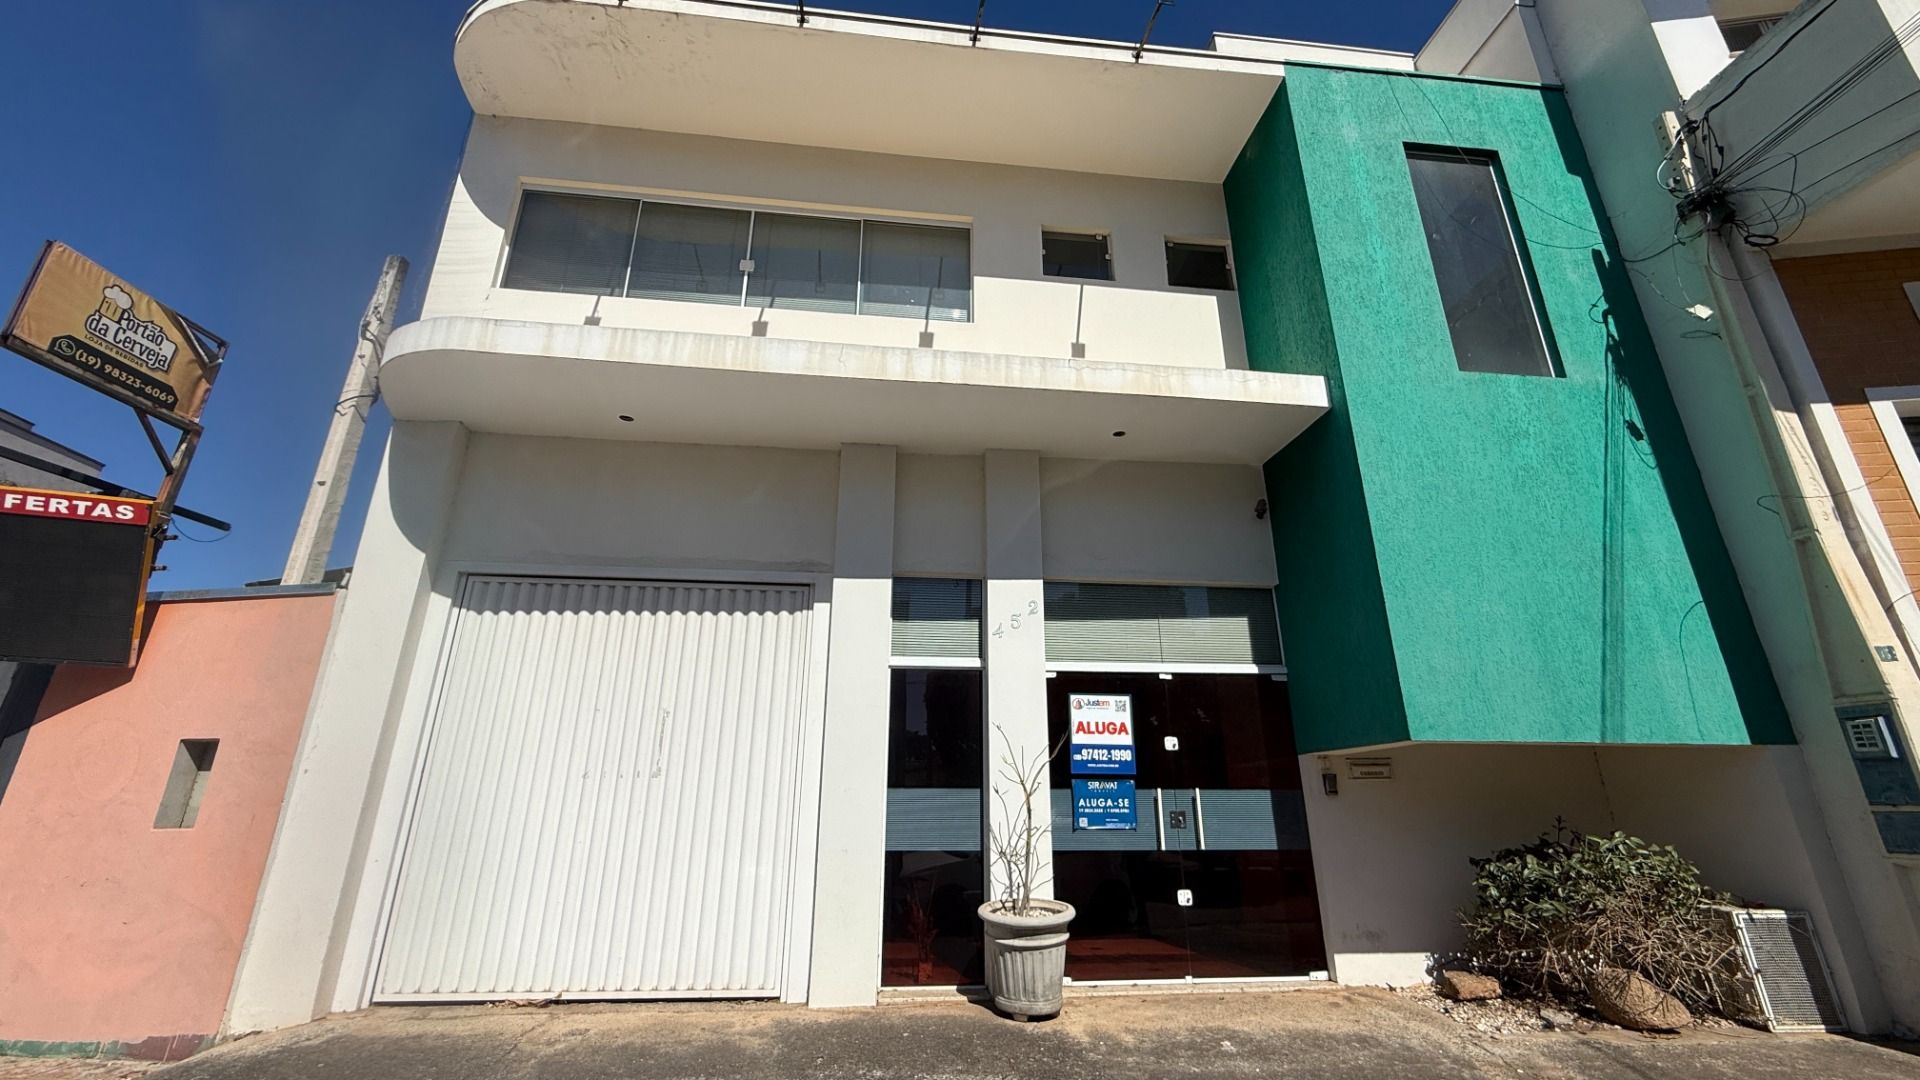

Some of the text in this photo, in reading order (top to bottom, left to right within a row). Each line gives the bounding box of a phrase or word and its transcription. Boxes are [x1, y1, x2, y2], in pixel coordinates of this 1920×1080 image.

[89, 313, 168, 370] da Cerveja
[117, 311, 165, 346] Portão
[84, 334, 144, 368] LOJA DE BEBIDAS
[75, 349, 175, 404] (19) 98323-6069
[1075, 721, 1129, 735] ALUGA
[1078, 798, 1129, 807] ALUGA-SE
